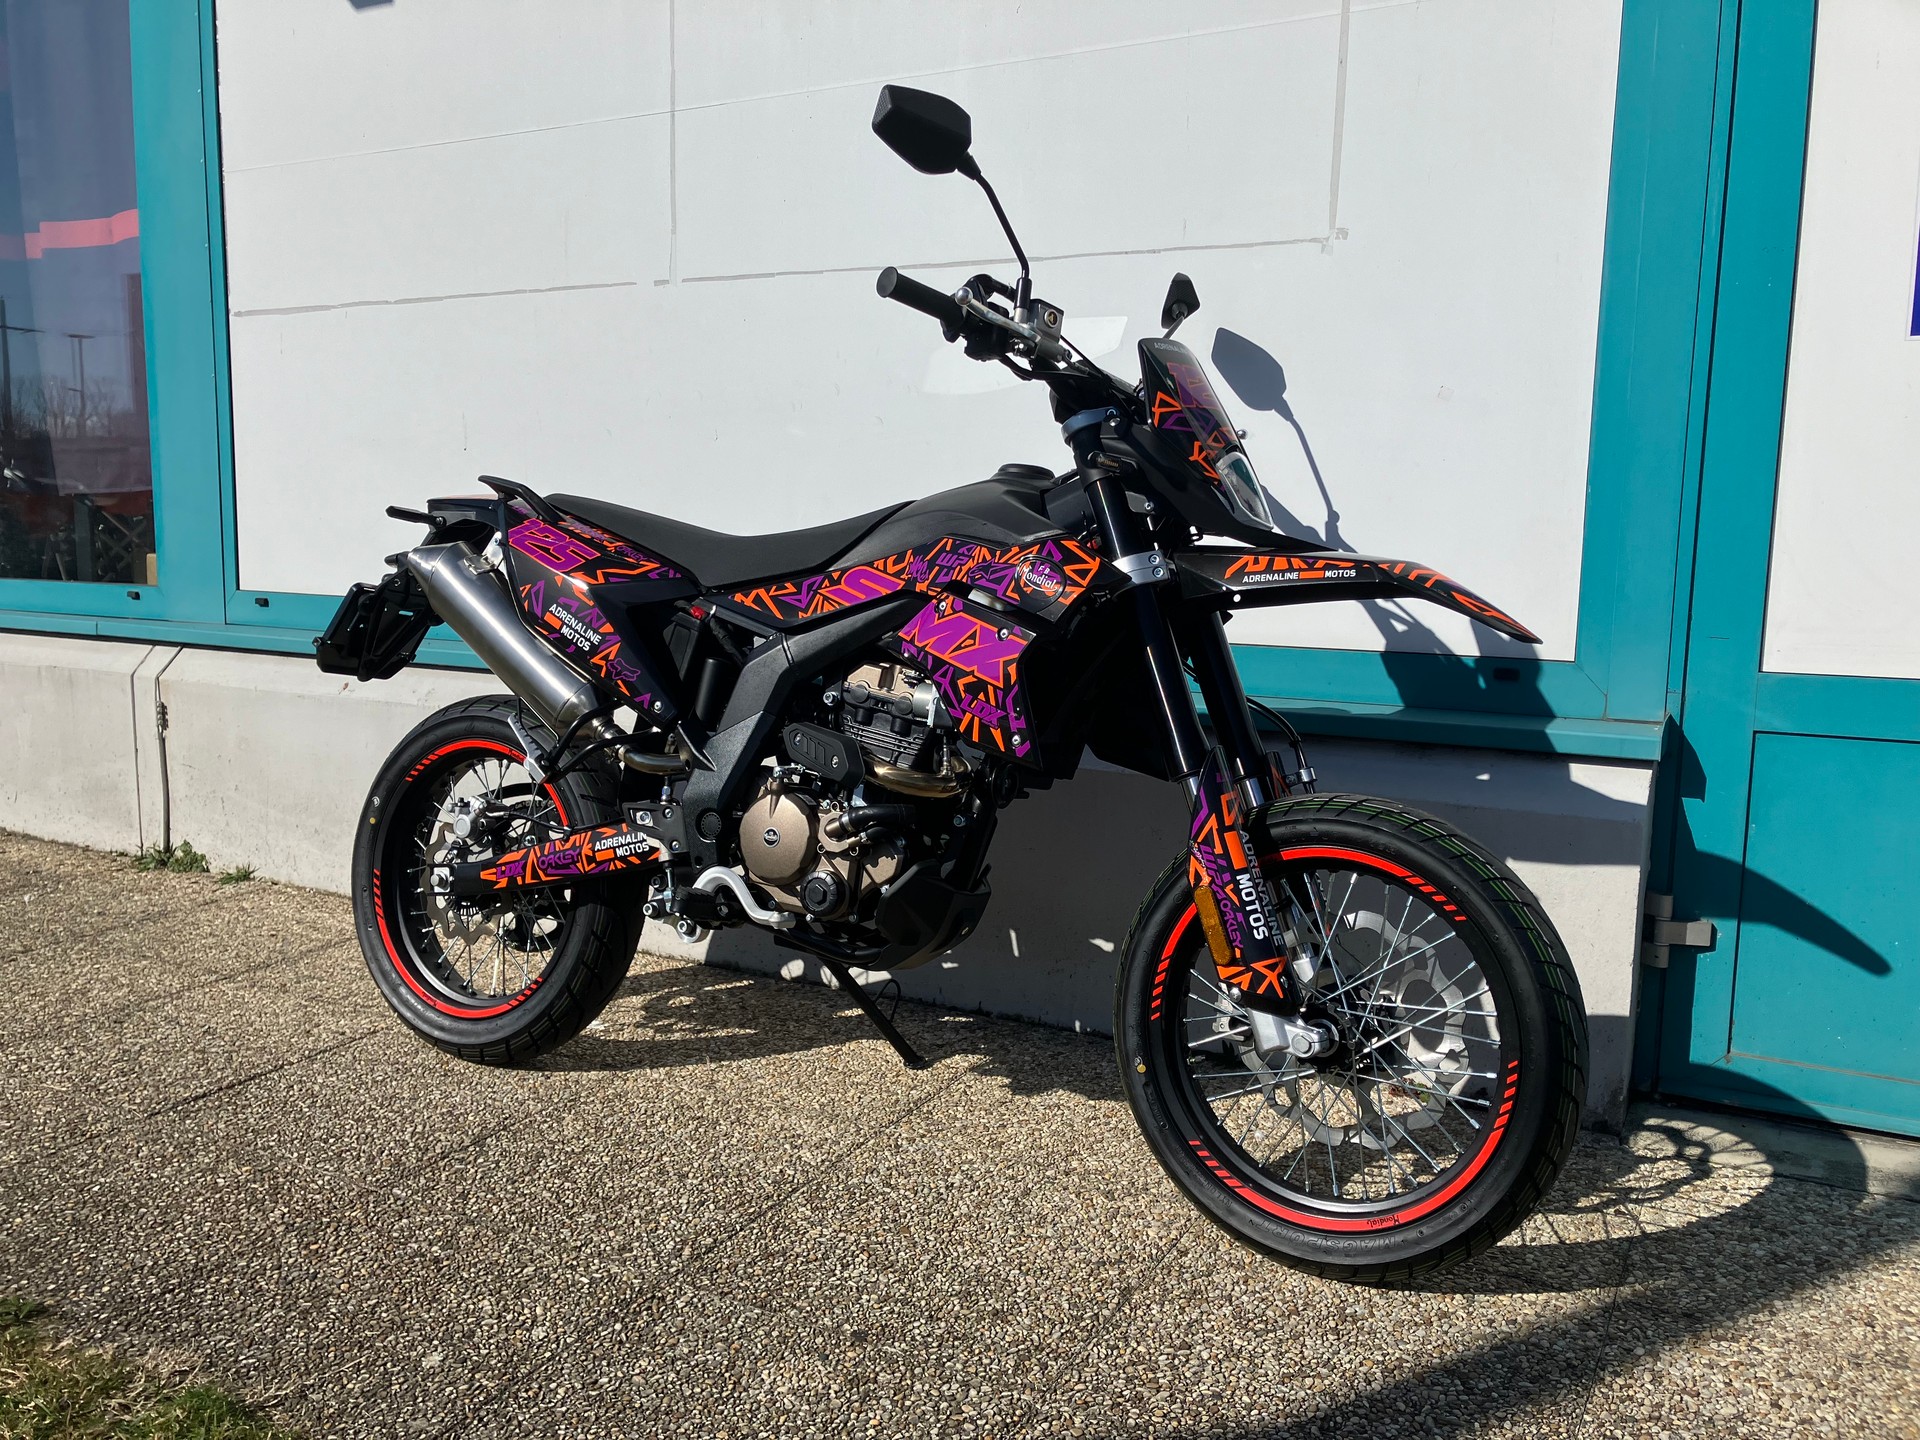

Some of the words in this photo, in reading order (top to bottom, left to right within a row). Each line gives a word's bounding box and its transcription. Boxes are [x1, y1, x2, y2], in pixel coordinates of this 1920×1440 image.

[508, 518, 601, 572] 125
[1022, 565, 1058, 591] Mondial
[1242, 571, 1299, 584] ADRENALINE
[1324, 569, 1356, 579] MOTOS
[549, 603, 602, 645] ADRENALINE
[560, 624, 592, 652] MOTOS
[898, 599, 1029, 688] MX
[538, 848, 581, 869] OAKLEY
[615, 841, 649, 858] MOTOS
[1239, 830, 1284, 948] ADRENALINE
[1236, 873, 1269, 940] MOTOS
[1254, 1219, 1397, 1254] MAGSPORT
[1366, 1214, 1400, 1229] Mondial
